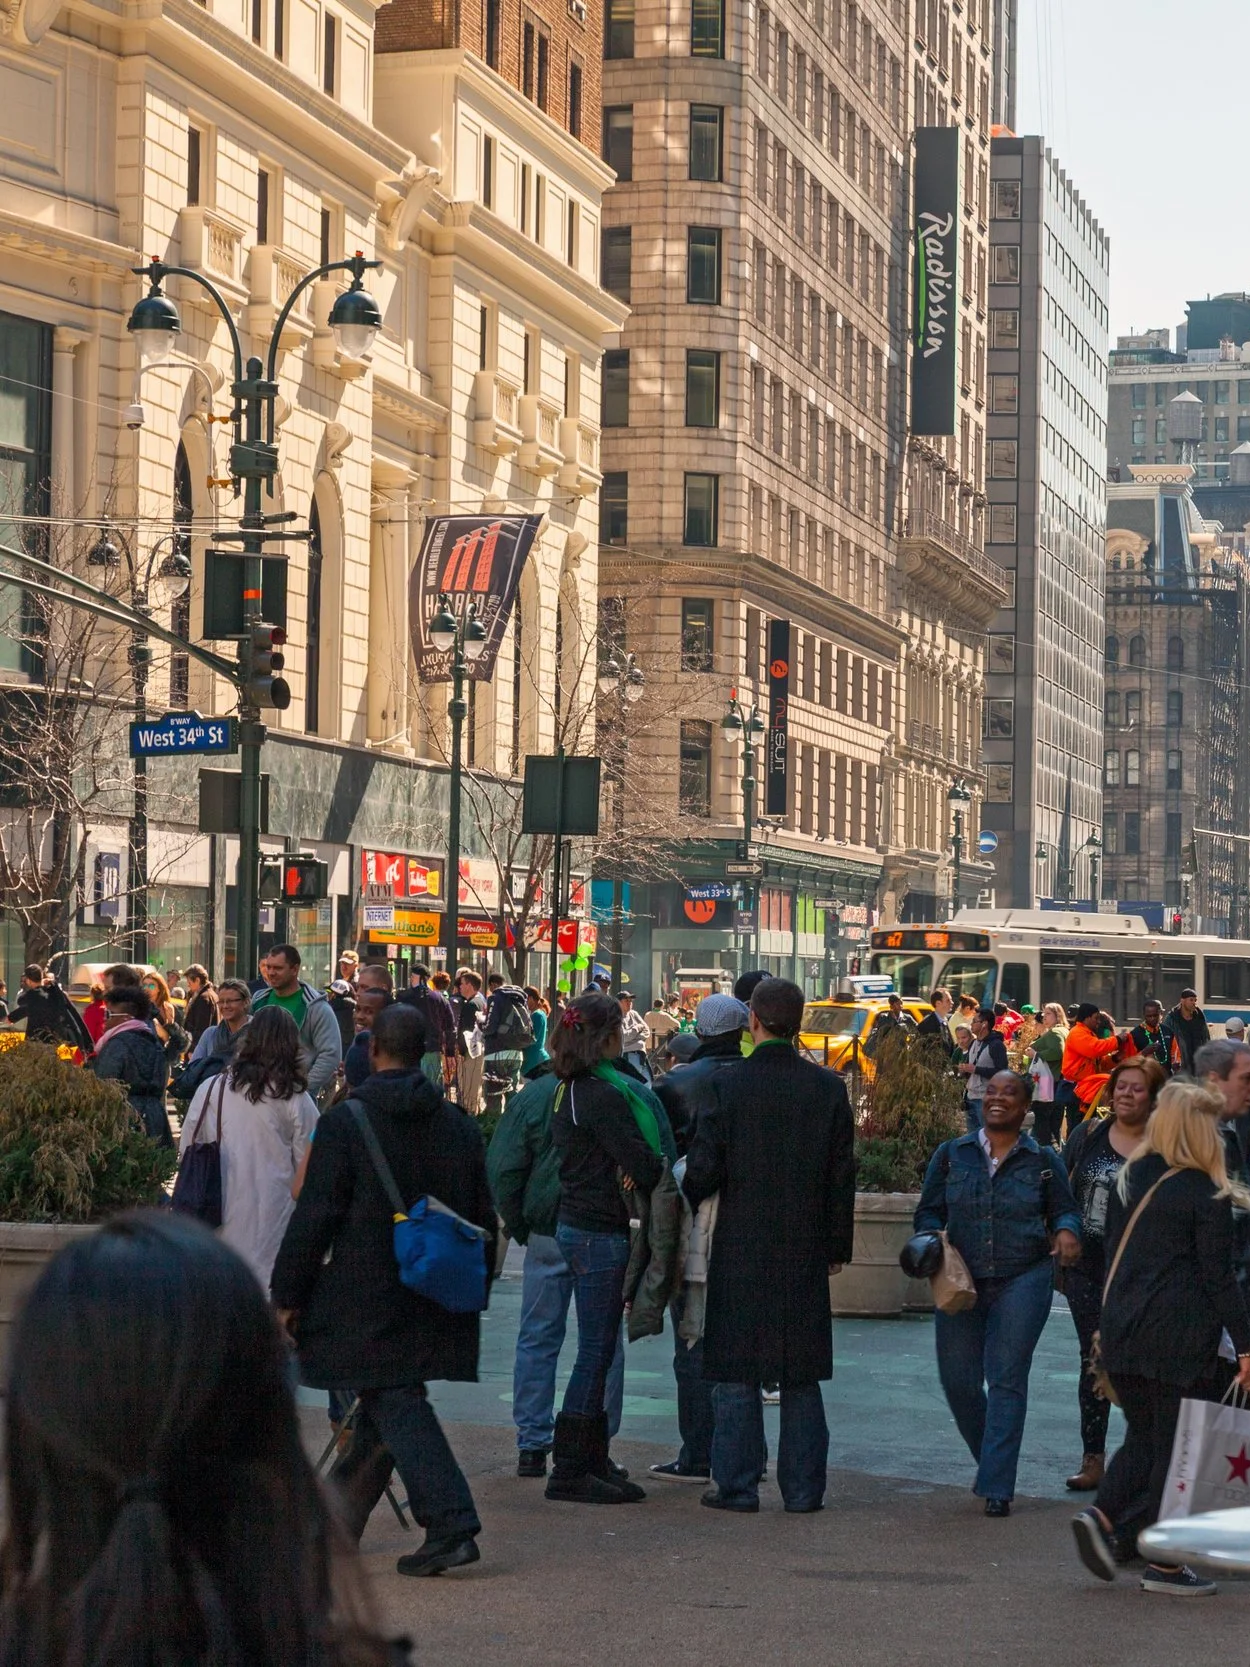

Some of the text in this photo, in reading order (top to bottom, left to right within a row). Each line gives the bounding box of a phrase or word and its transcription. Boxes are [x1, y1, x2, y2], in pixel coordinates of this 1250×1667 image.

[918, 212, 954, 358] Radisson
[170, 717, 191, 725] B'WAY
[138, 725, 224, 748] West 34th St
[369, 885, 391, 897] ATM
[690, 888, 731, 898] West 33rd S
[366, 911, 392, 922] INTERNET
